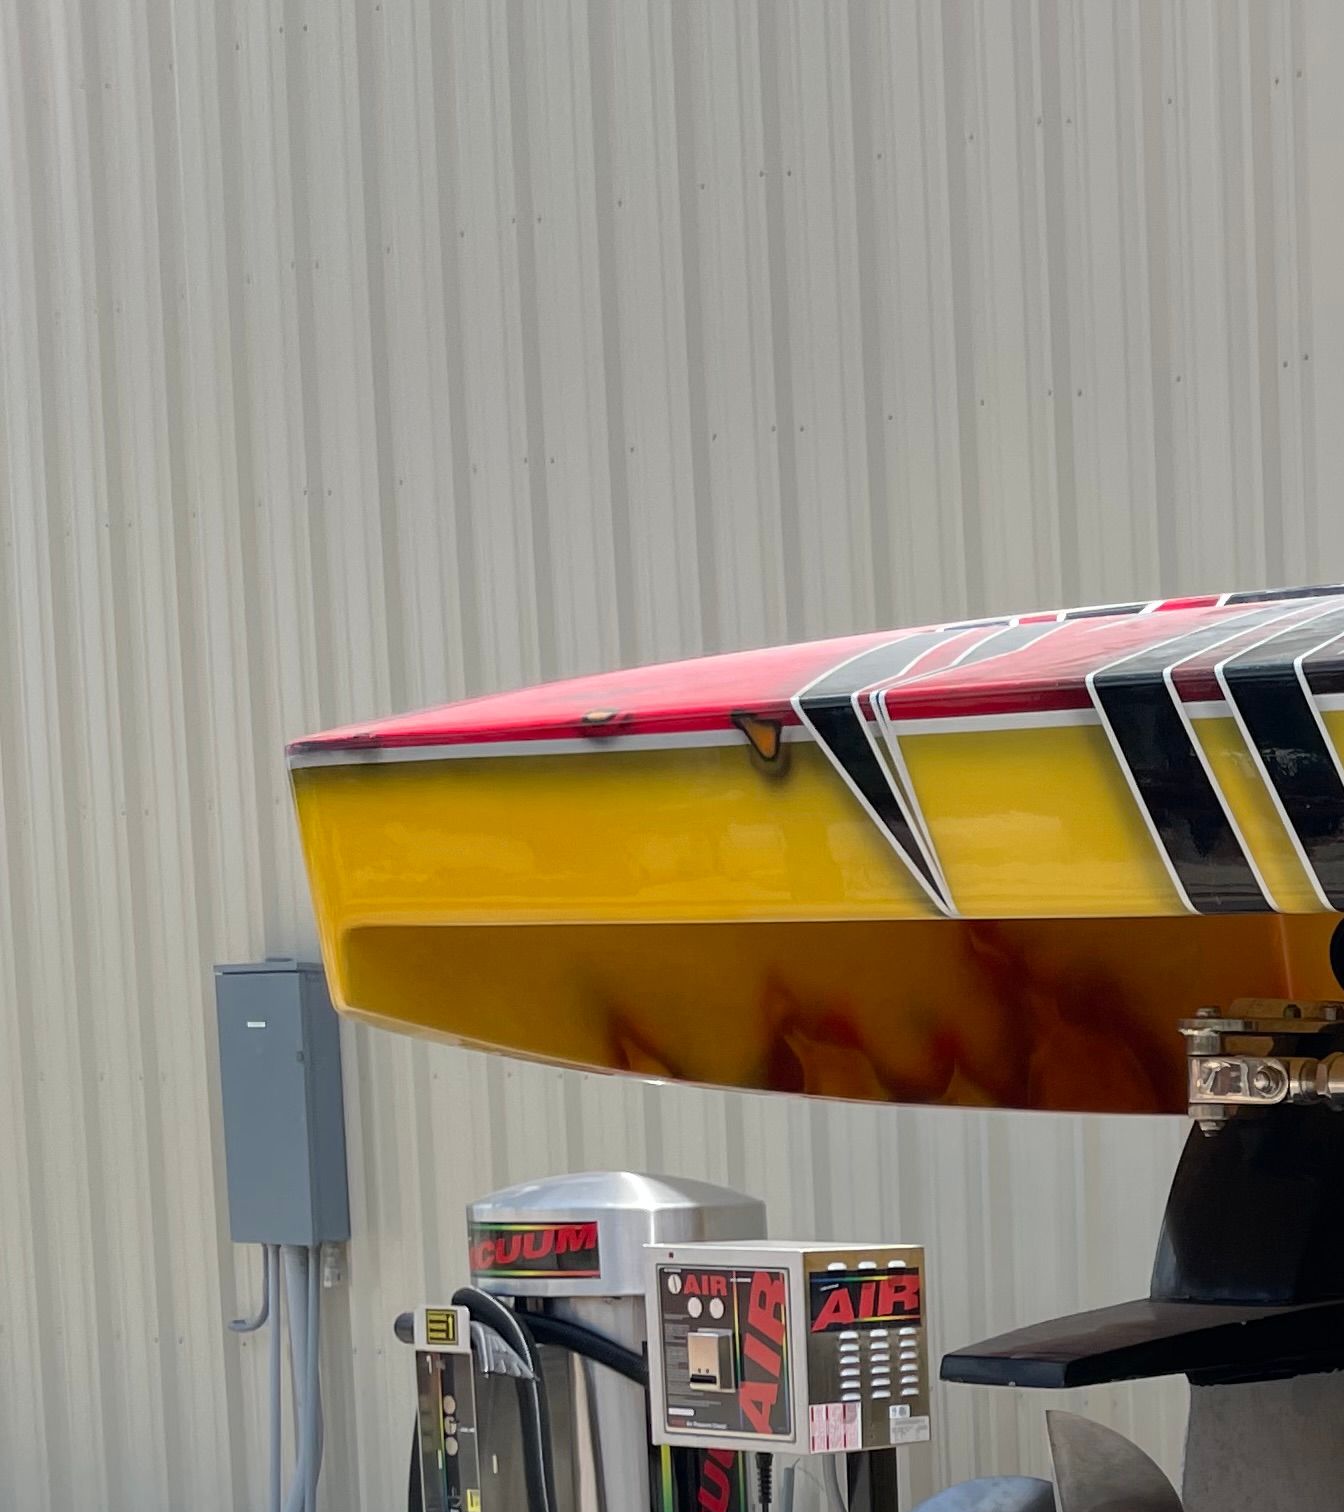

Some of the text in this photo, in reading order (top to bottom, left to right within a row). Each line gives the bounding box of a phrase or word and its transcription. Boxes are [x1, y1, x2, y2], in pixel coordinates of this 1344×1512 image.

[683, 1273, 728, 1297] AIR
[810, 1274, 921, 1334] AIR
[738, 1271, 786, 1435] AIR
